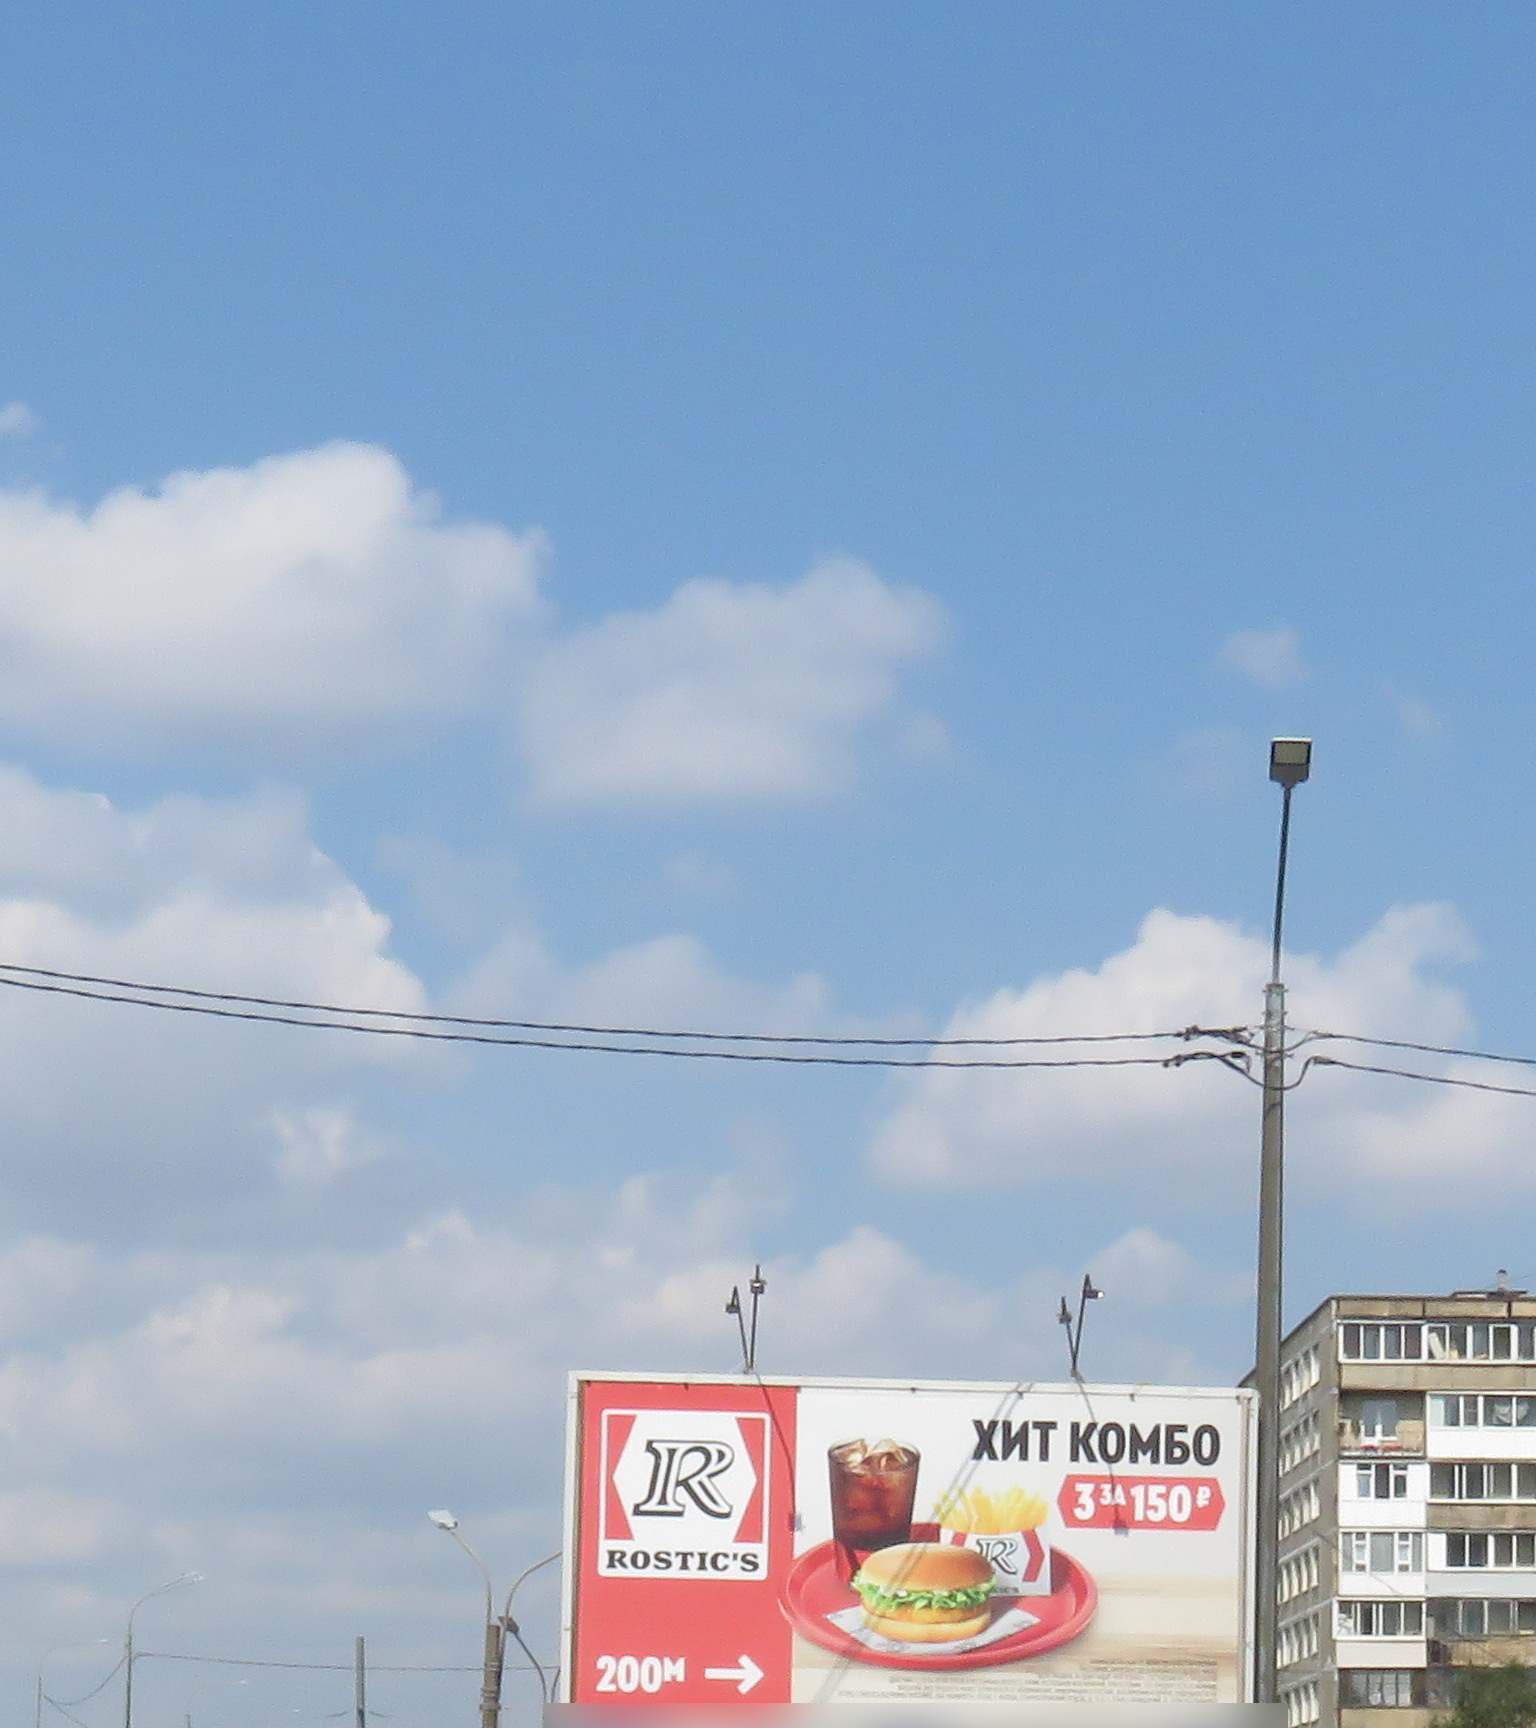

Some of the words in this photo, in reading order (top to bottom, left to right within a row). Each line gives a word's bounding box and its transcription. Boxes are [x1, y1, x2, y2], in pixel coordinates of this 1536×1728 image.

[972, 1419, 1057, 1462] ХИТ
[1070, 1421, 1221, 1466] КОМБО
[632, 1439, 735, 1519] R
[1073, 1482, 1095, 1520] 3
[606, 1549, 760, 1573] ROSTIC'S
